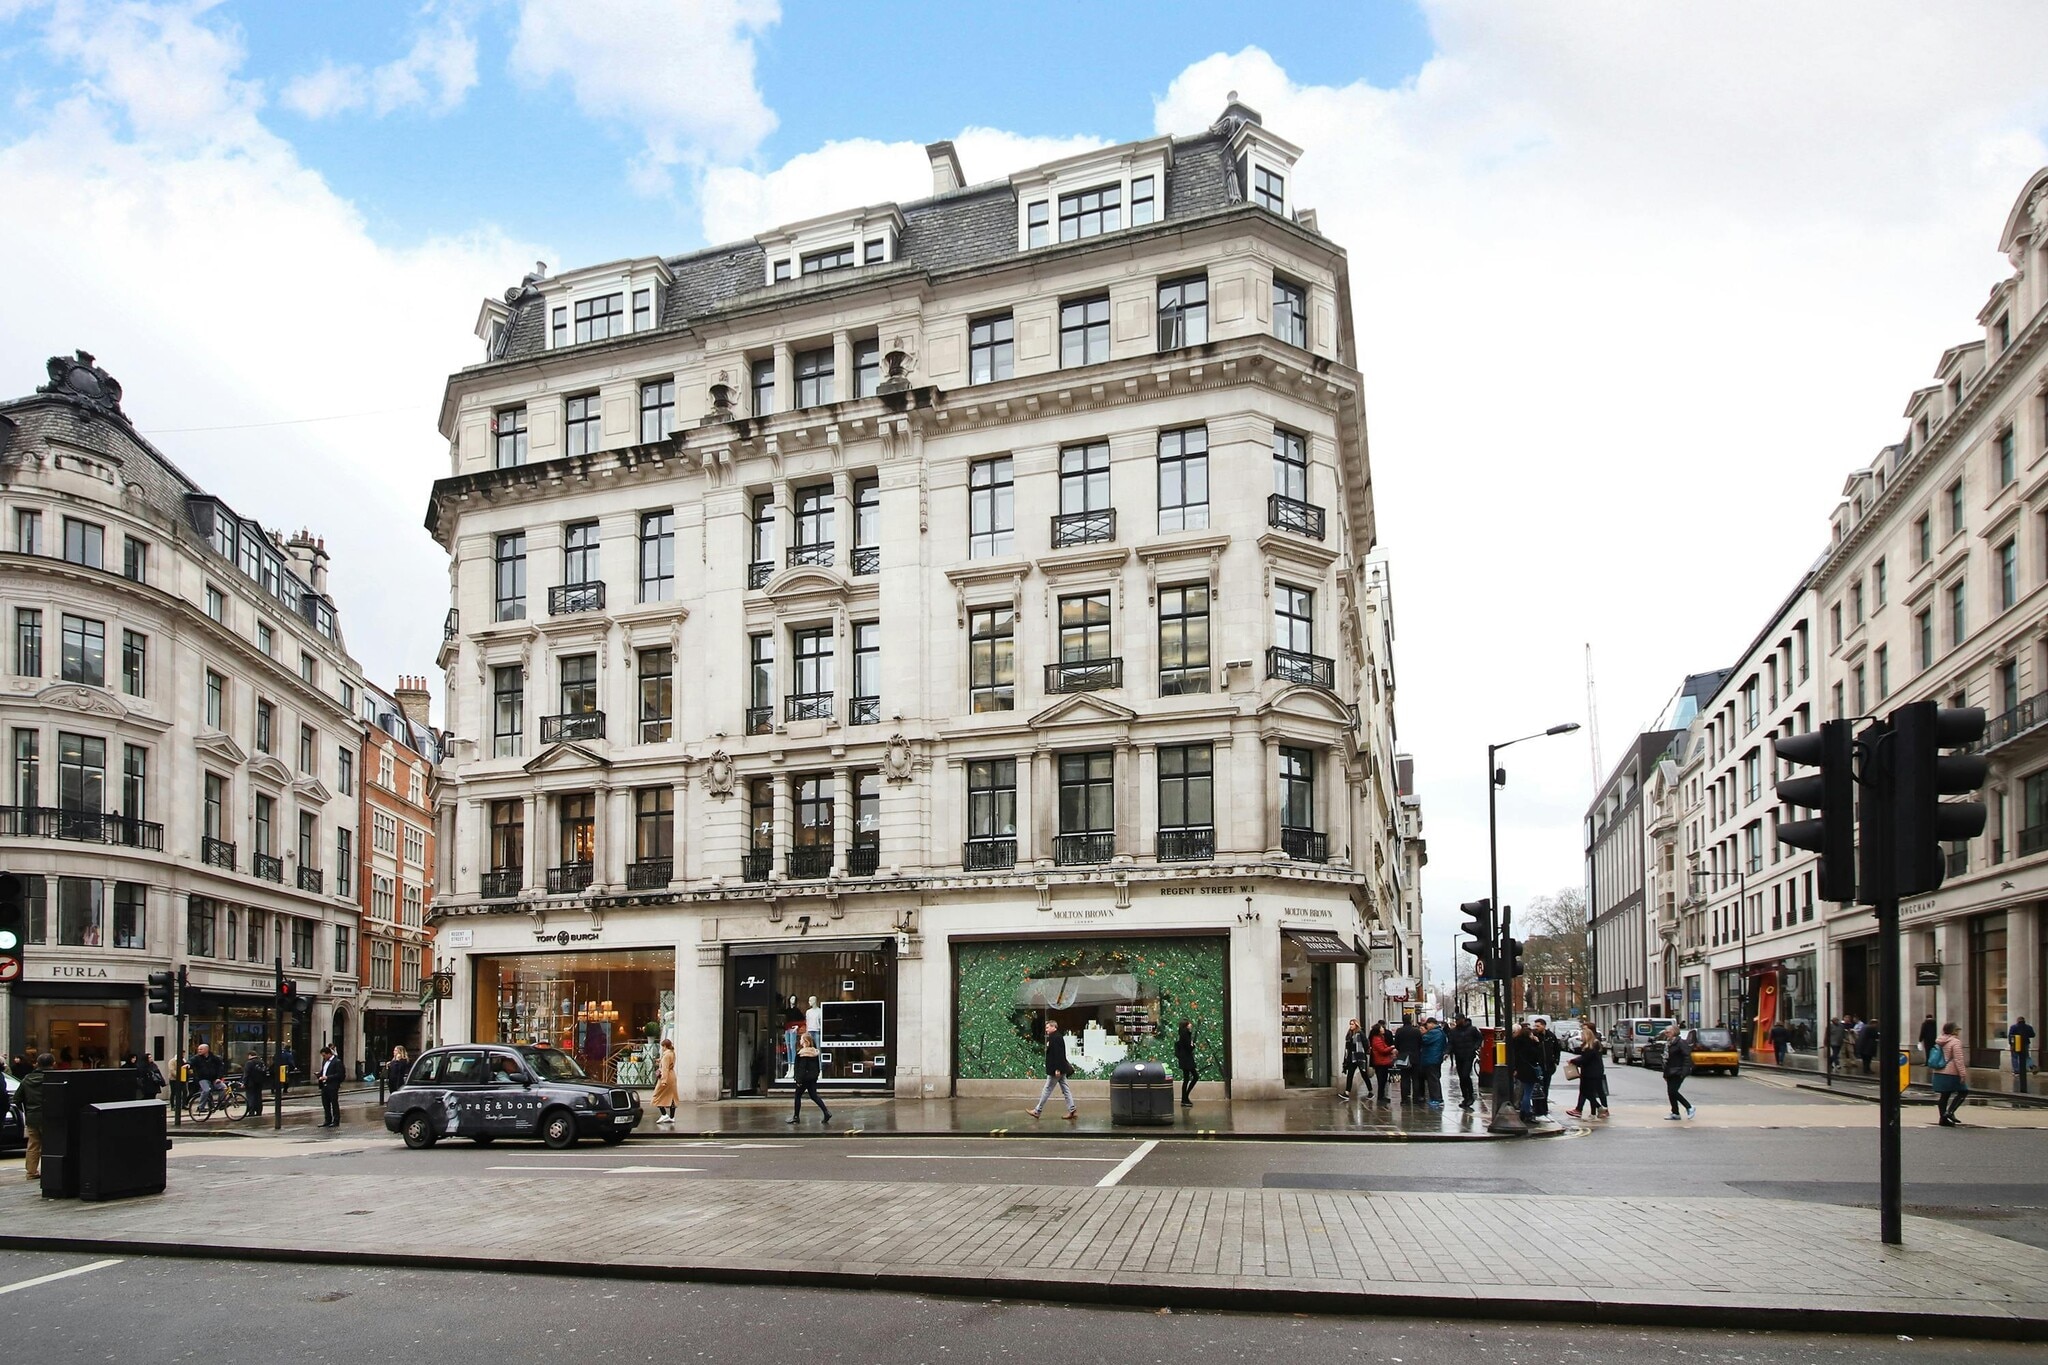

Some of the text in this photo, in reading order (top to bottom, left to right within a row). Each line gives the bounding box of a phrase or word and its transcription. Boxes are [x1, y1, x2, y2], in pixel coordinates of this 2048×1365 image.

[1160, 887, 1196, 896] REGENT
[1284, 907, 1333, 918] MOLTON BROWN
[1898, 900, 1936, 917] ONGCHAMP
[1053, 909, 1114, 919] MOLTON BROWN
[798, 916, 811, 936] 7
[536, 933, 599, 943] TORY BURCH
[1298, 935, 1335, 943] MOLTON
[1305, 942, 1343, 950] BROWN
[53, 966, 108, 978] FURLA
[251, 979, 271, 988] FURLA
[466, 1101, 543, 1112] rag & bone
